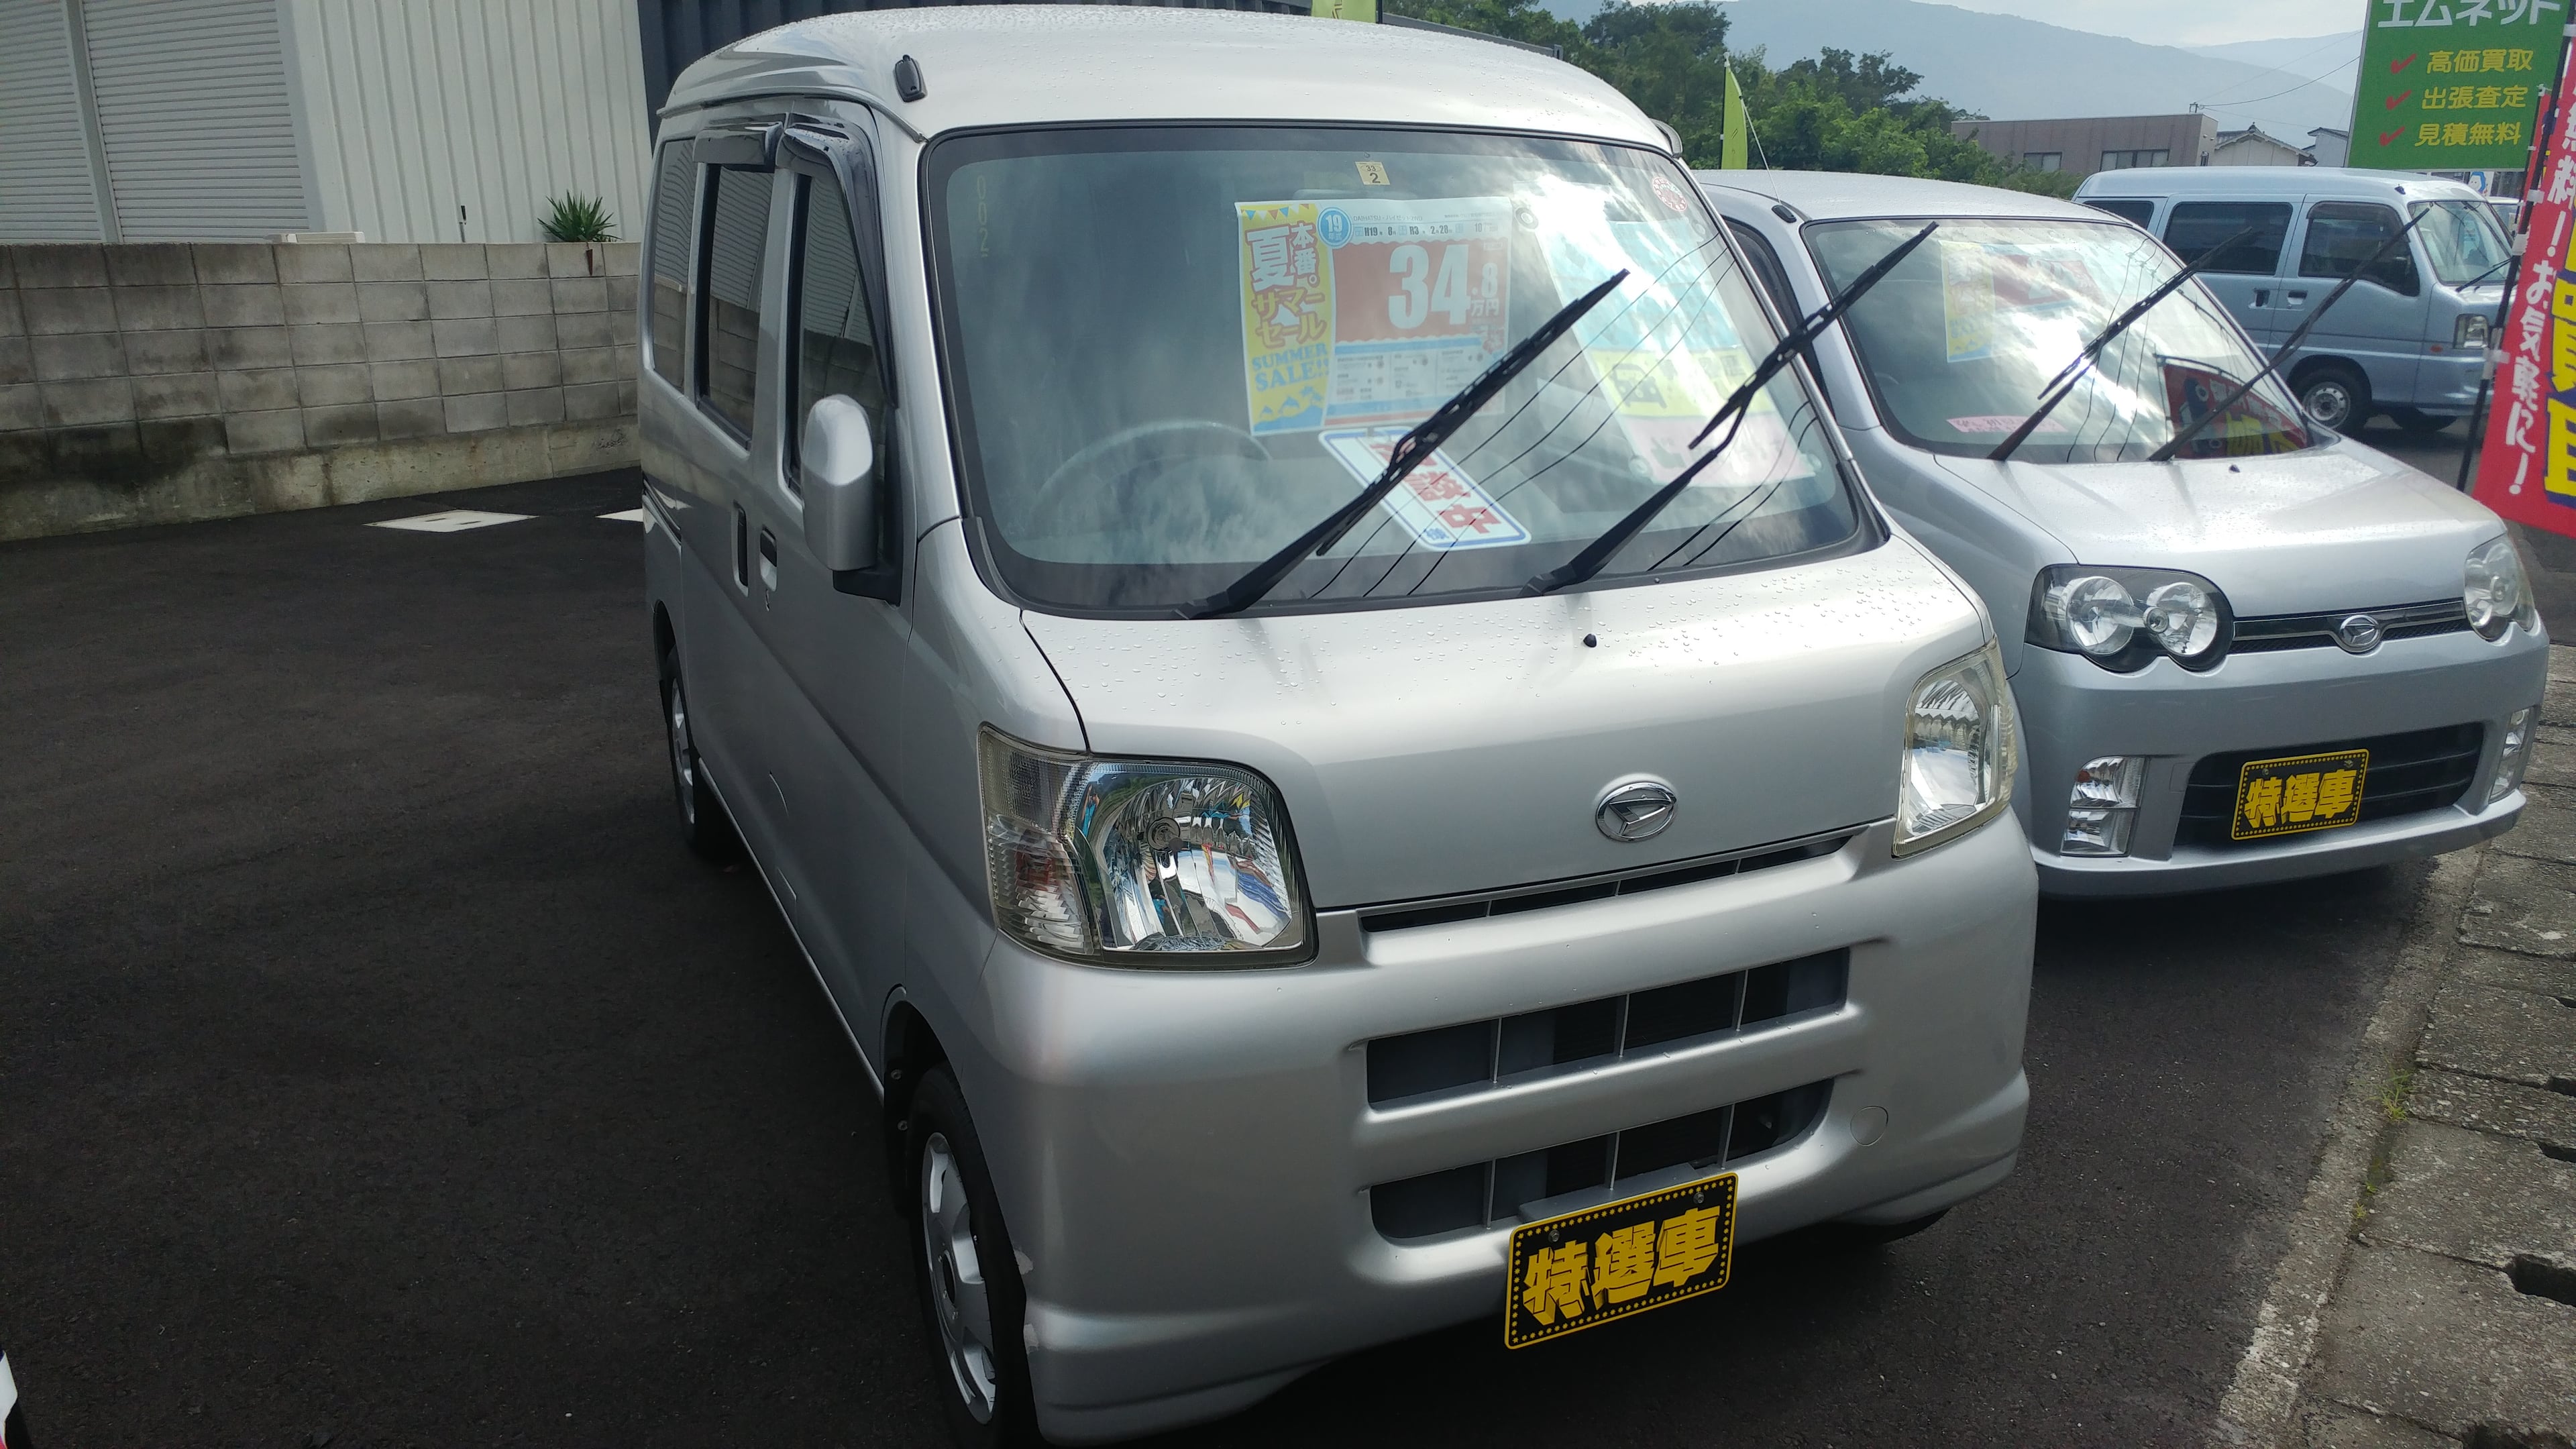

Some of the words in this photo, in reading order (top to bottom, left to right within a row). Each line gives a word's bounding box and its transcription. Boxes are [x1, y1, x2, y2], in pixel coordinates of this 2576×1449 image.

[2426, 49, 2534, 74] 高価買取
[2422, 85, 2528, 110] 出張査定
[2415, 122, 2522, 147] 見積無料
[1369, 172, 1381, 183] 2
[1326, 215, 1342, 232] 19
[1246, 225, 1295, 292] 夏
[1252, 287, 1324, 321] サマー
[1470, 299, 1499, 317] 万円
[1256, 311, 1327, 348] セール
[1252, 343, 1327, 371] SUMMER
[2245, 769, 2357, 828] 特選車
[1522, 1205, 1721, 1326] 特選車
